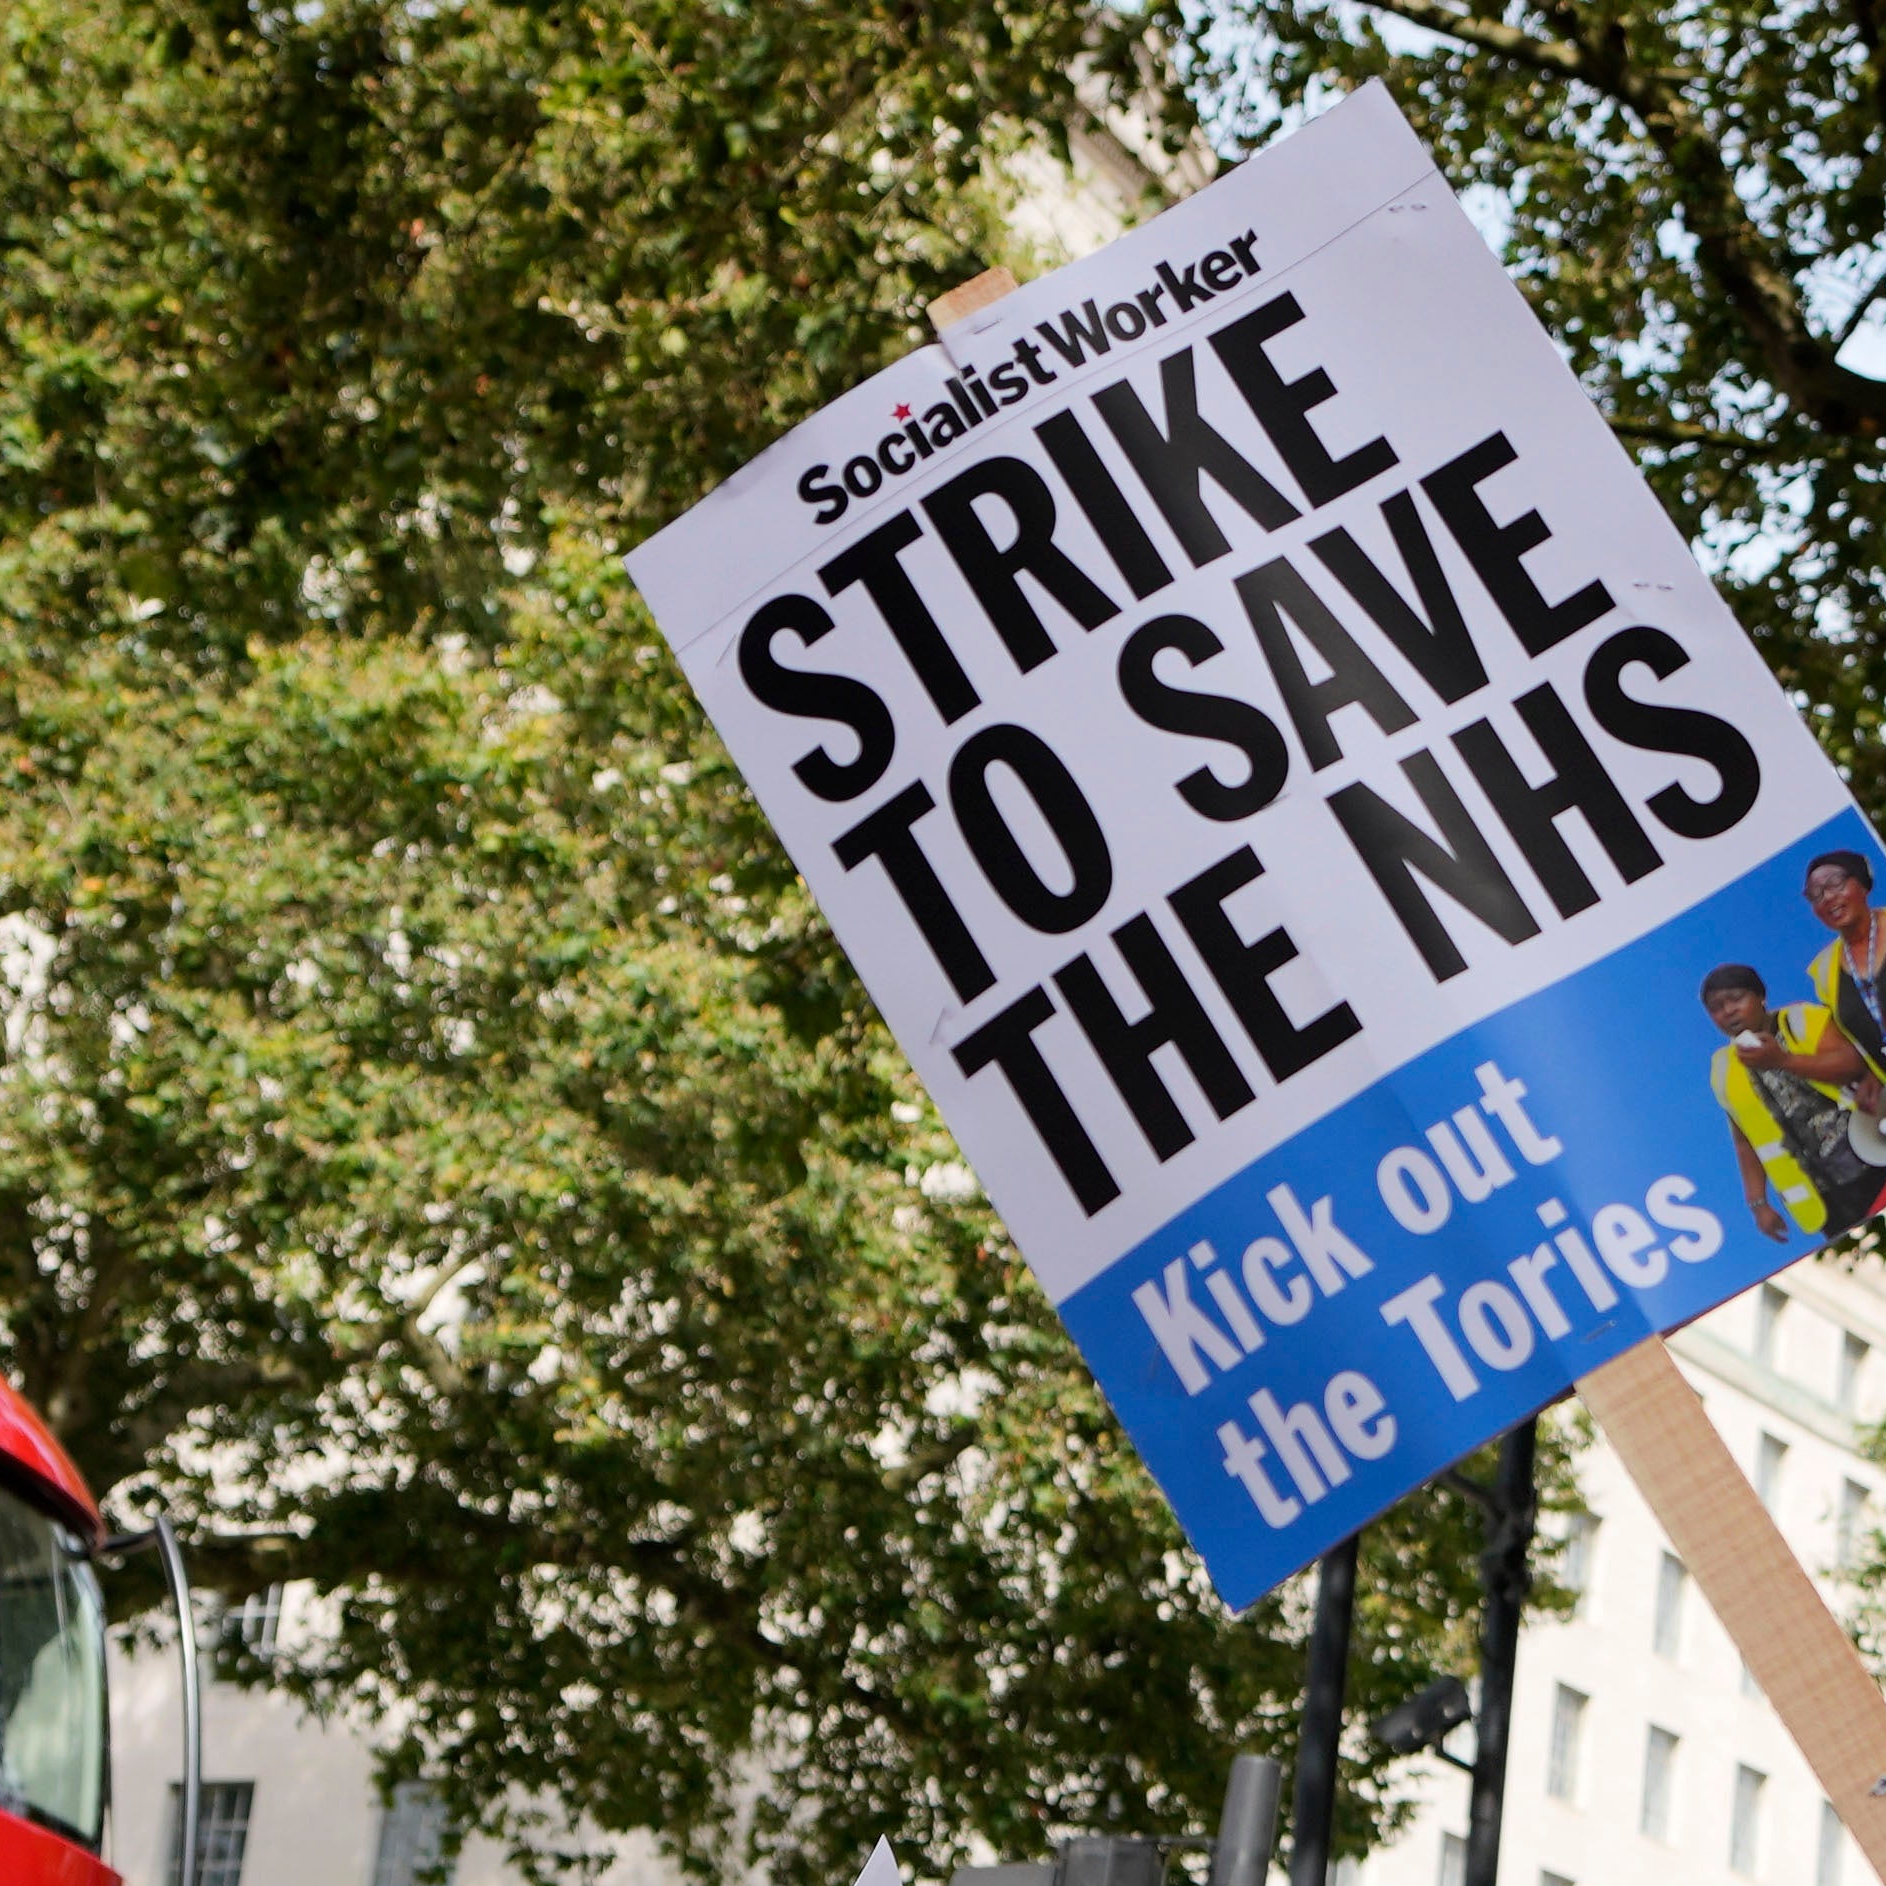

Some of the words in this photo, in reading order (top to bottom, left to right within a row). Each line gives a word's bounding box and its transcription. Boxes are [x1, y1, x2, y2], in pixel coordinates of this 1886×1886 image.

[737, 290, 1399, 802] STRIKE
[797, 338, 1057, 525] Socialist
[1035, 228, 1262, 368] Worker
[833, 721, 1115, 1005] TO
[1116, 430, 1615, 823] SAVE
[950, 844, 1363, 1218] THE
[1324, 626, 1761, 984] NHS
[1132, 1182, 1374, 1397] Kick
[1376, 1057, 1563, 1238] out
[1215, 1362, 1398, 1530] the
[1380, 1171, 1724, 1403] Tories
